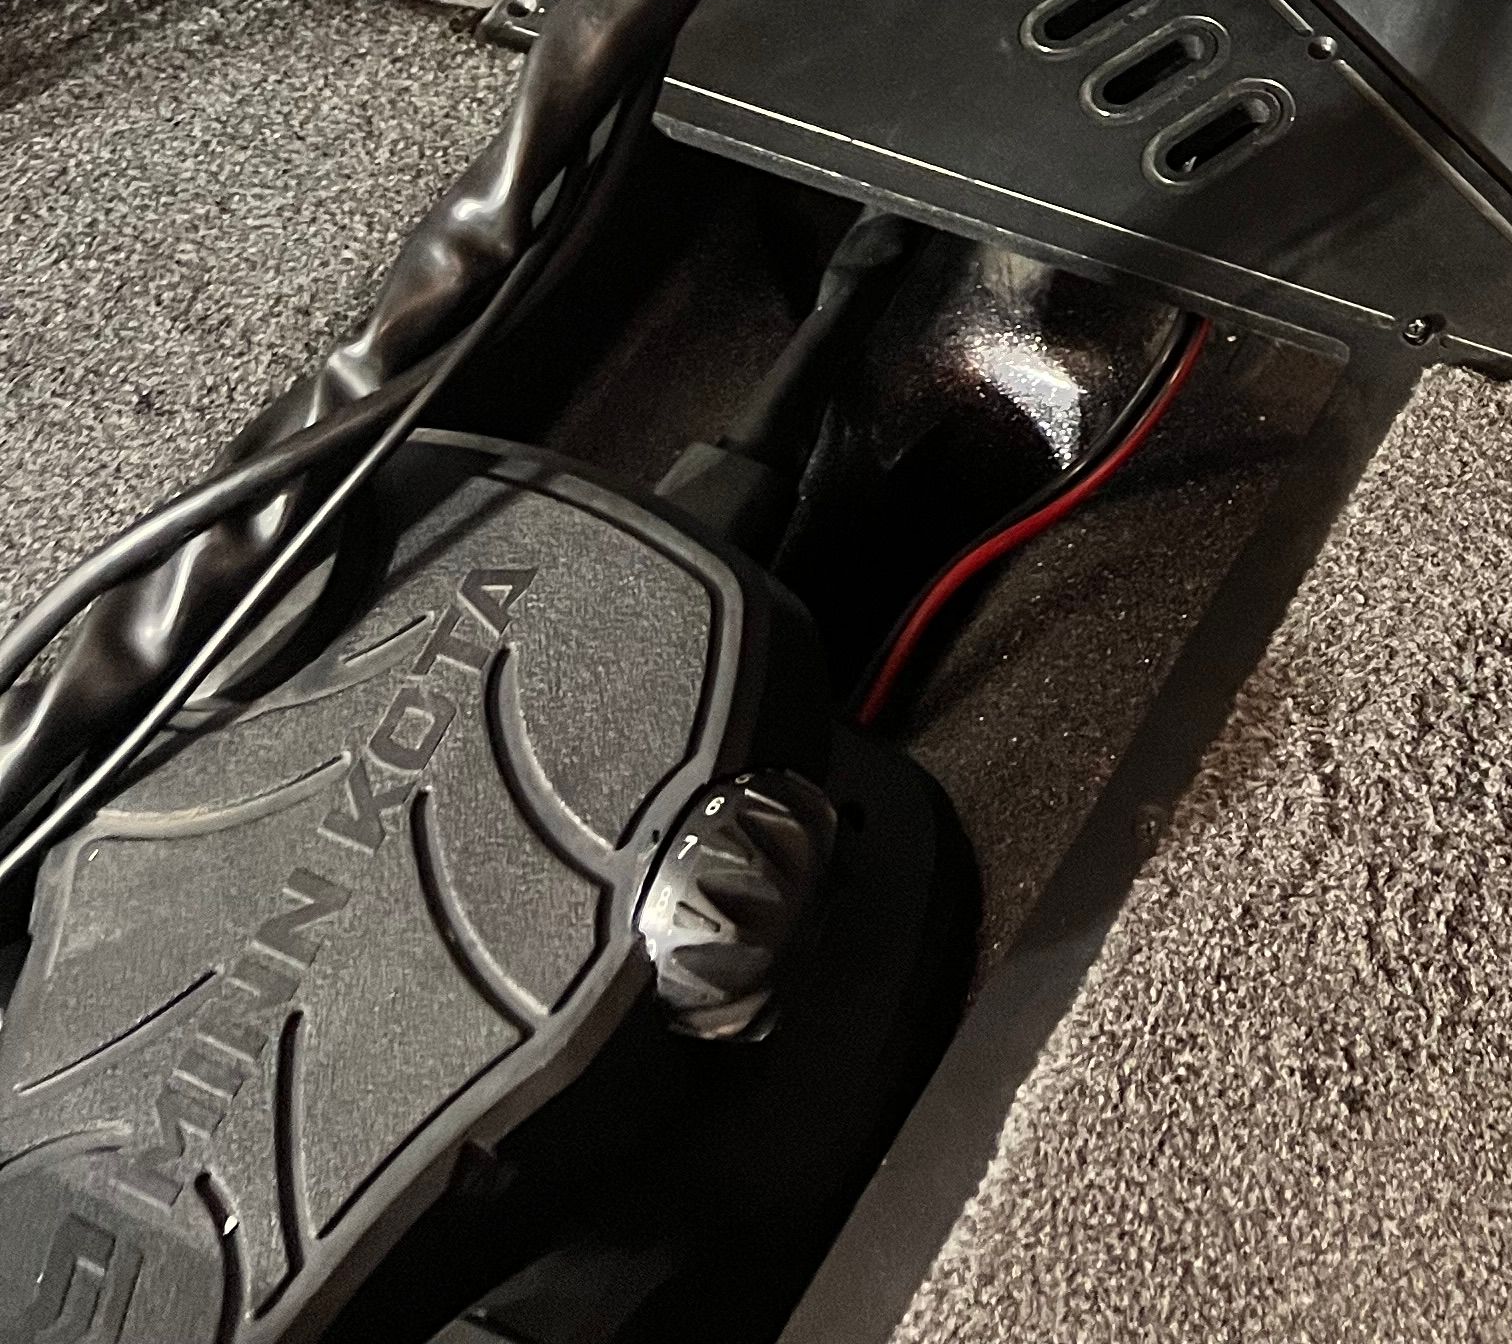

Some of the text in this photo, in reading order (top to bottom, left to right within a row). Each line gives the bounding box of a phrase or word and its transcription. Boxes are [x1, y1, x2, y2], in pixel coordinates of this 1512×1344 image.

[316, 567, 539, 856] KOTA
[677, 834, 698, 859] 7
[705, 796, 725, 815] 6
[107, 866, 352, 1212] MINN
